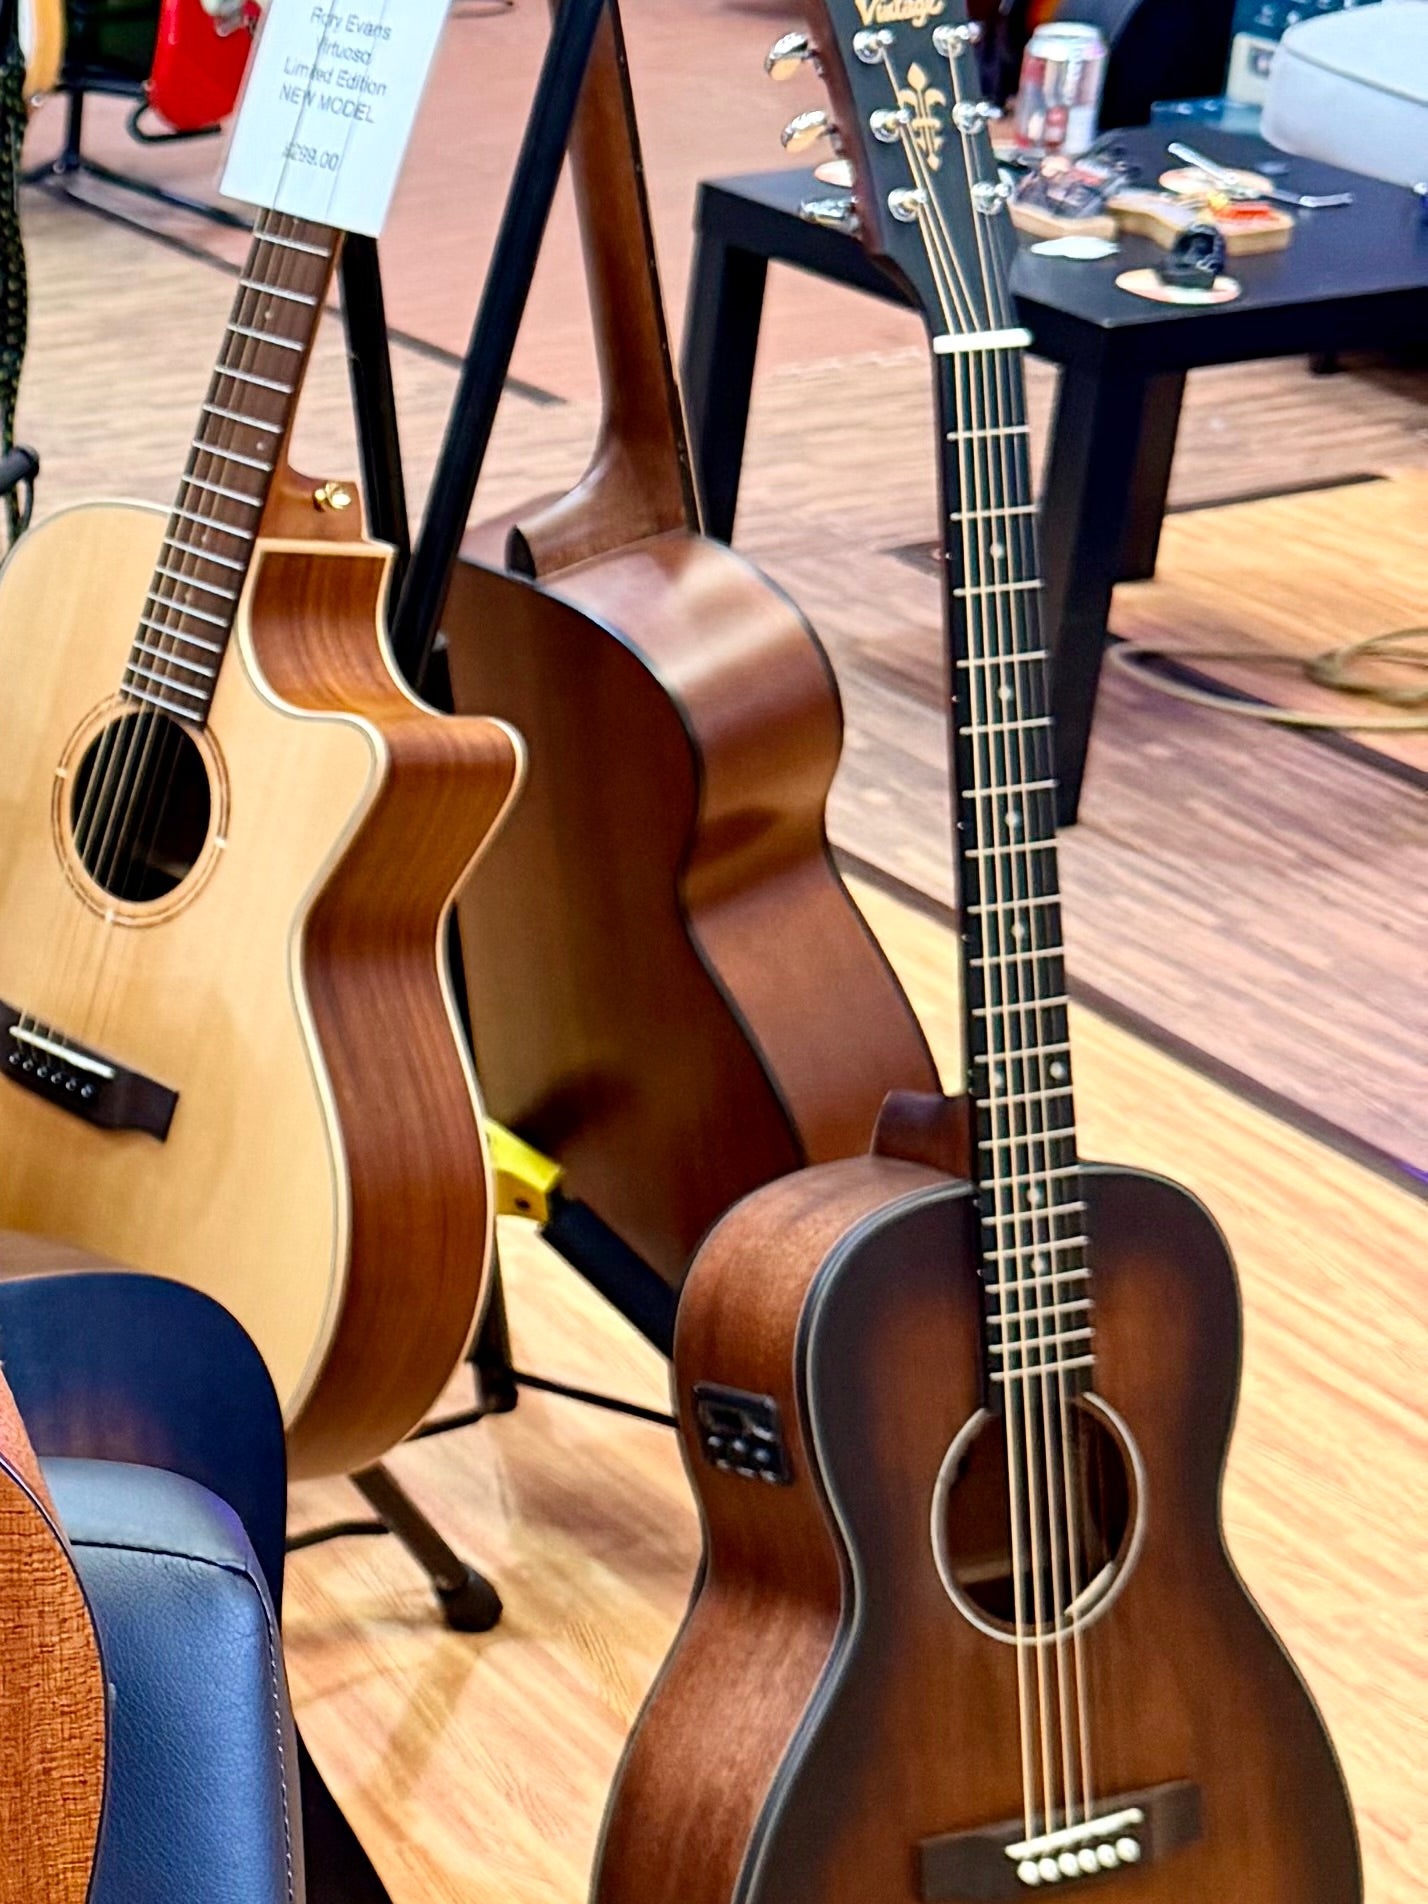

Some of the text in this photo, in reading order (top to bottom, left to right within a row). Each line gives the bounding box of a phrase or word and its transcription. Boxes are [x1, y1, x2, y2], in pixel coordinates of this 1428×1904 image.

[345, 14, 392, 40] Evans
[337, 70, 387, 97] Edition
[279, 85, 375, 124] NEW MODEL
